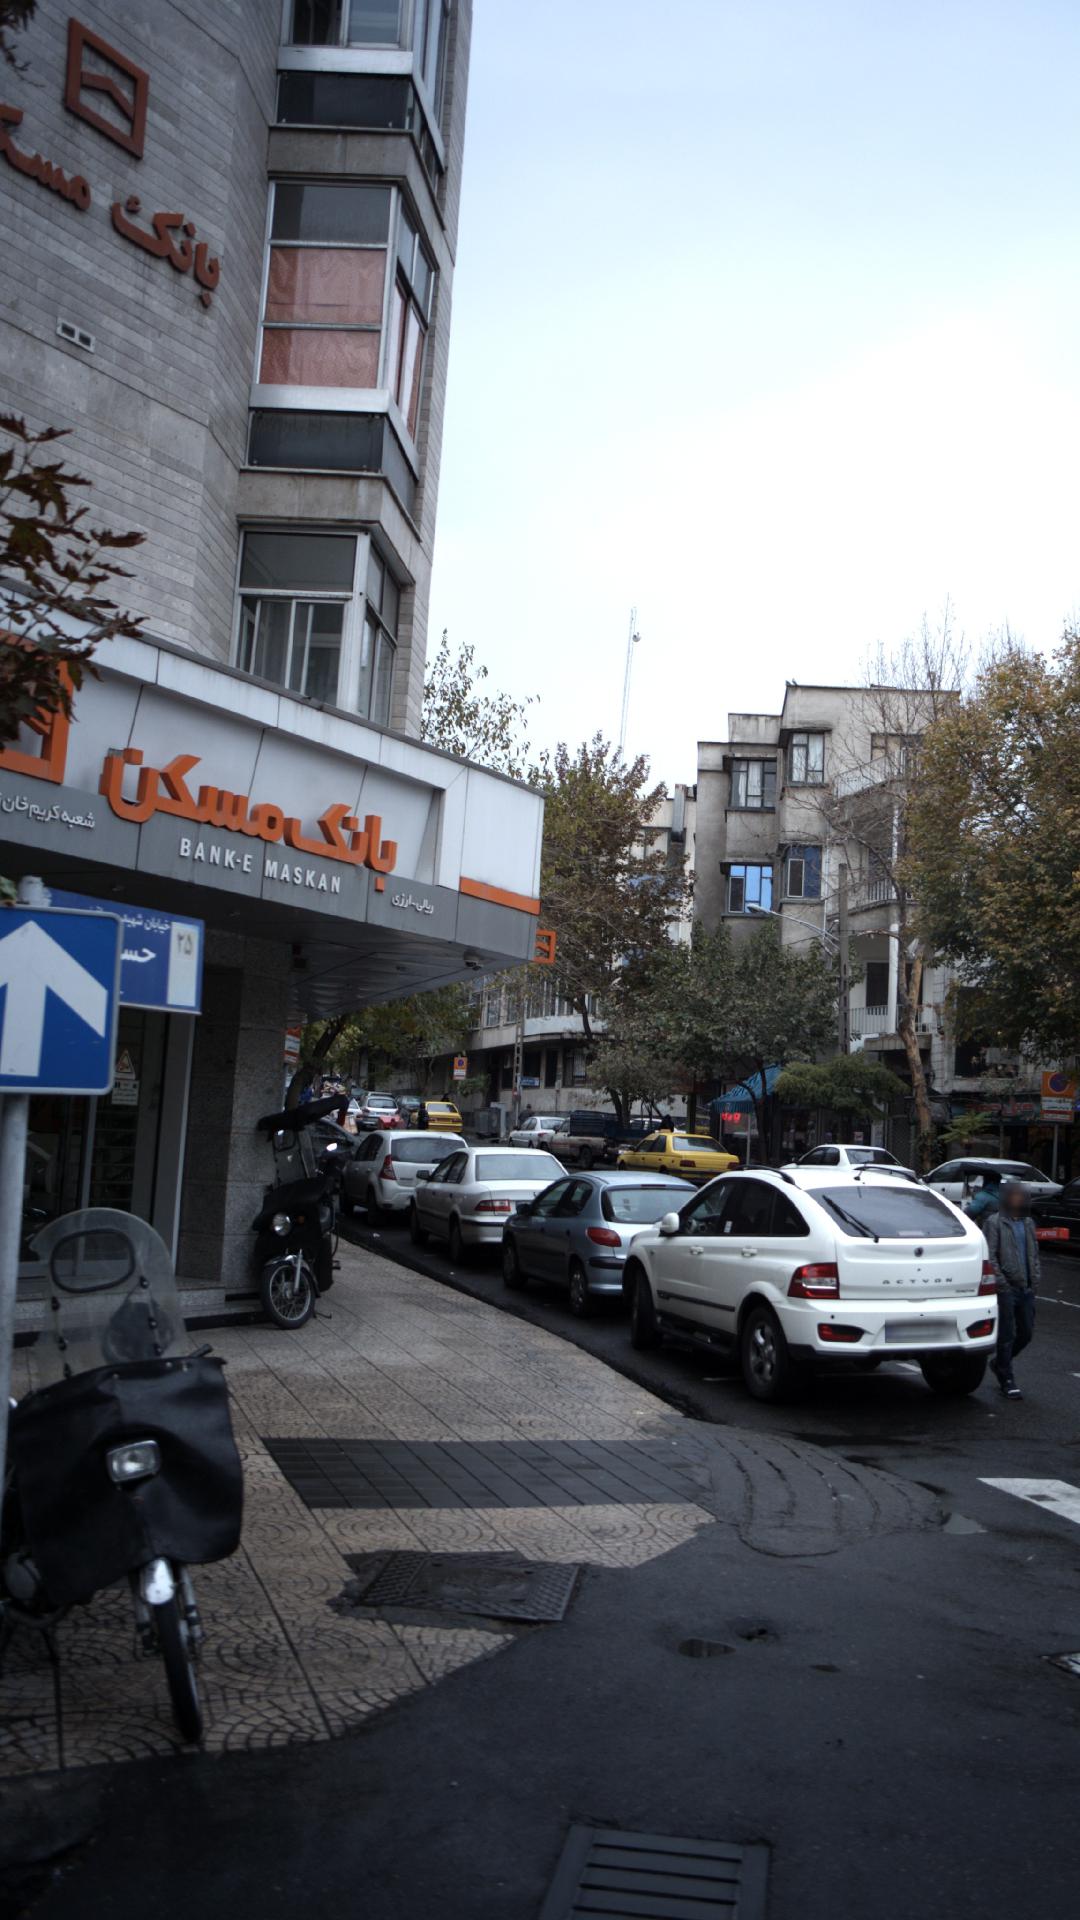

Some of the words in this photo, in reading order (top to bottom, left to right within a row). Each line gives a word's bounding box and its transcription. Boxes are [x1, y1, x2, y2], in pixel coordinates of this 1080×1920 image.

[111, 195, 220, 308] بانک
[28, 804, 60, 822] کریم
[100, 747, 285, 842] مسکن
[61, 812, 96, 828] شعبه
[179, 837, 253, 873] BANK-E
[264, 859, 341, 893] MASKAN
[284, 804, 398, 892] بانک
[144, 919, 171, 933] خیابان
[176, 932, 193, 956] ۲۵
